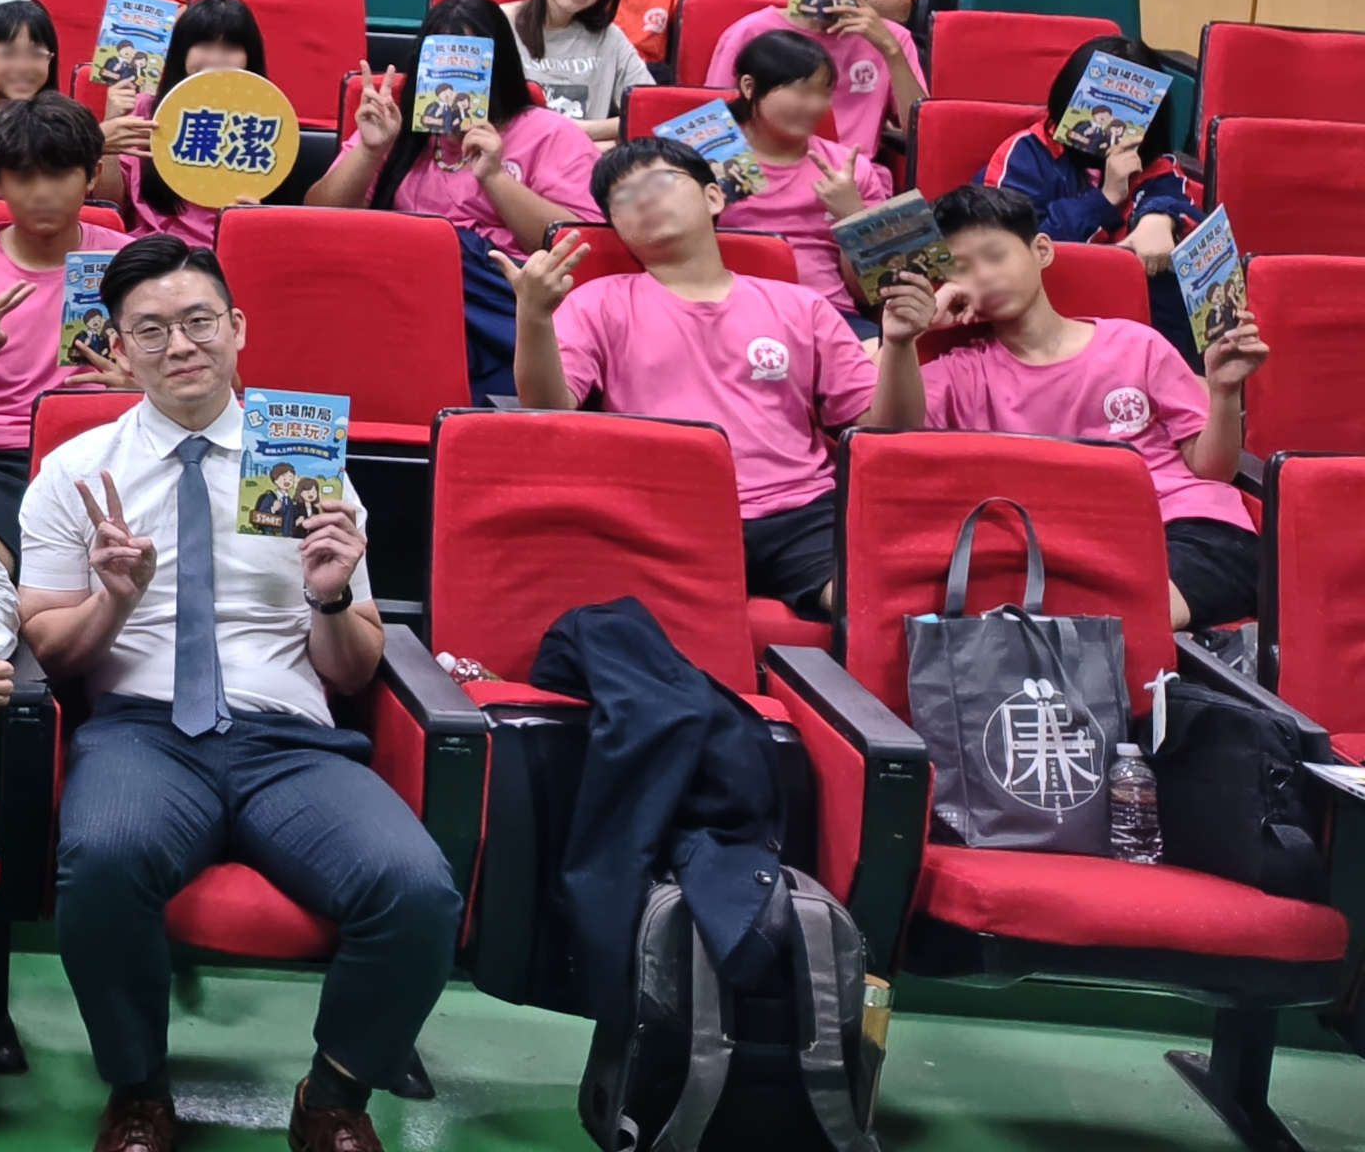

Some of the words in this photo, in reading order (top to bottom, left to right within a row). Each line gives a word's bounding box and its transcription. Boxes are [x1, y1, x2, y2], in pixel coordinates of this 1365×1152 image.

[172, 109, 278, 171] 廉潔
[268, 403, 332, 422] 職場開局
[269, 421, 330, 440] 怎麼玩?
[255, 513, 281, 525] START
